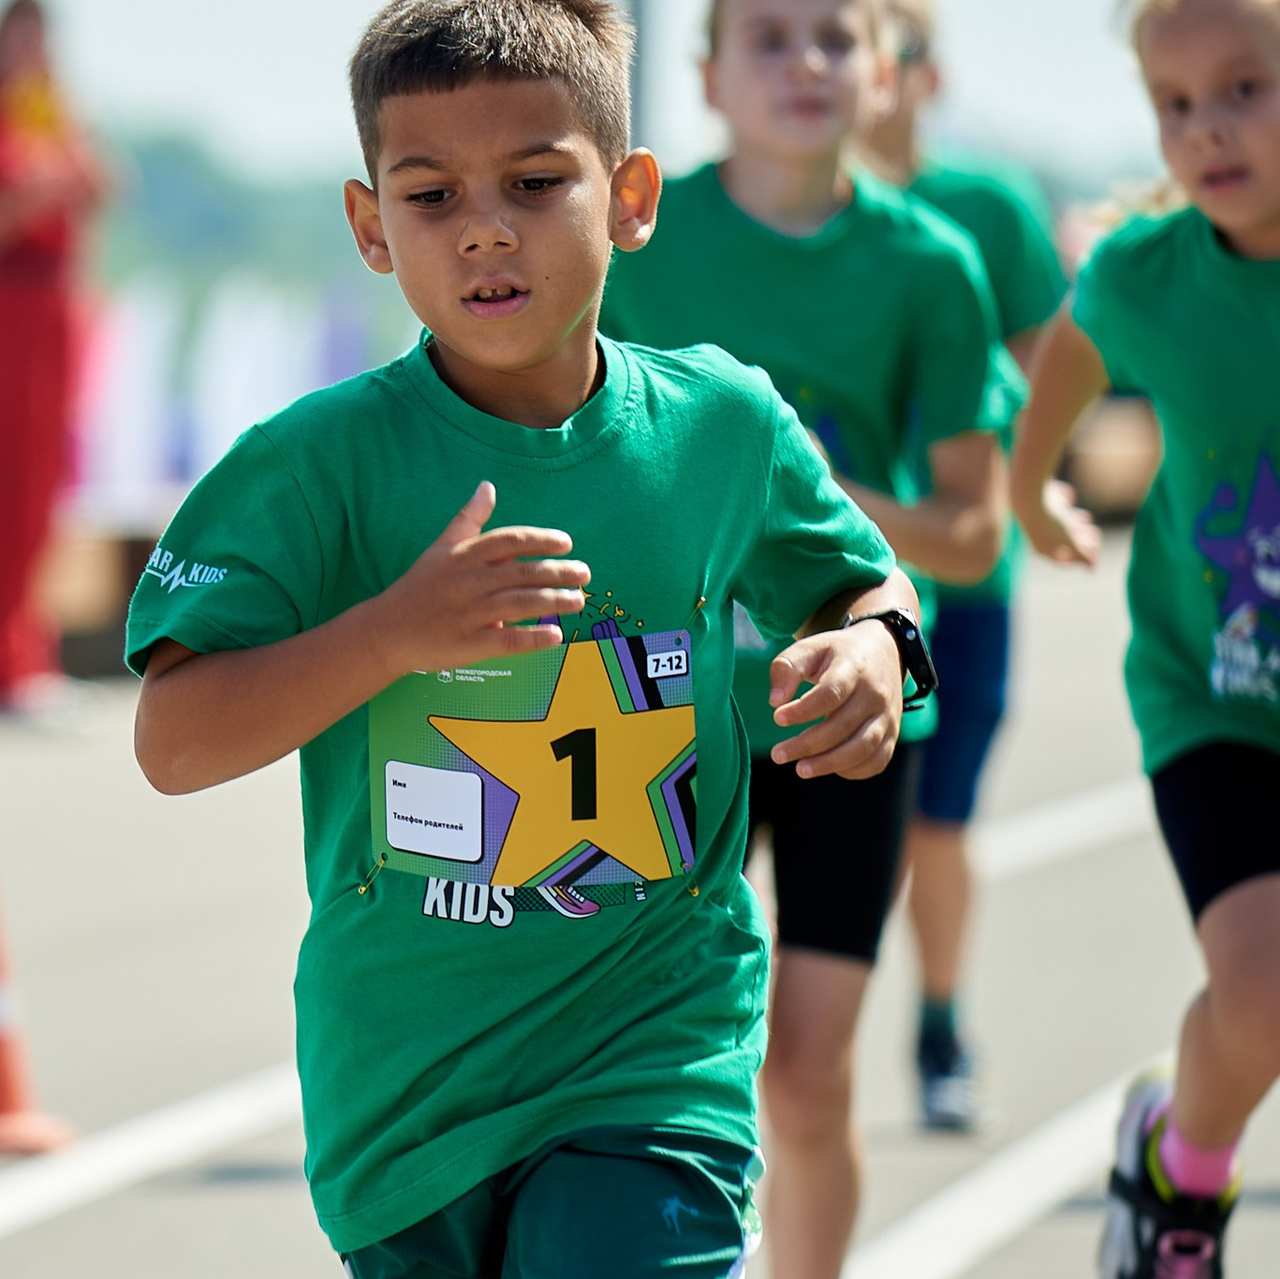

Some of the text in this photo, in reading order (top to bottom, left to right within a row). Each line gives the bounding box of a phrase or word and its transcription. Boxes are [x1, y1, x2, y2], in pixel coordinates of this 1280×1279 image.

[188, 563, 227, 583] KIDS
[652, 654, 683, 673] 7-12
[455, 675, 485, 683] ОБЛАСТЬ
[392, 779, 406, 788] Имя
[550, 727, 597, 821] 1
[393, 812, 464, 831] Телефон родителей
[422, 876, 516, 928] KIDS
